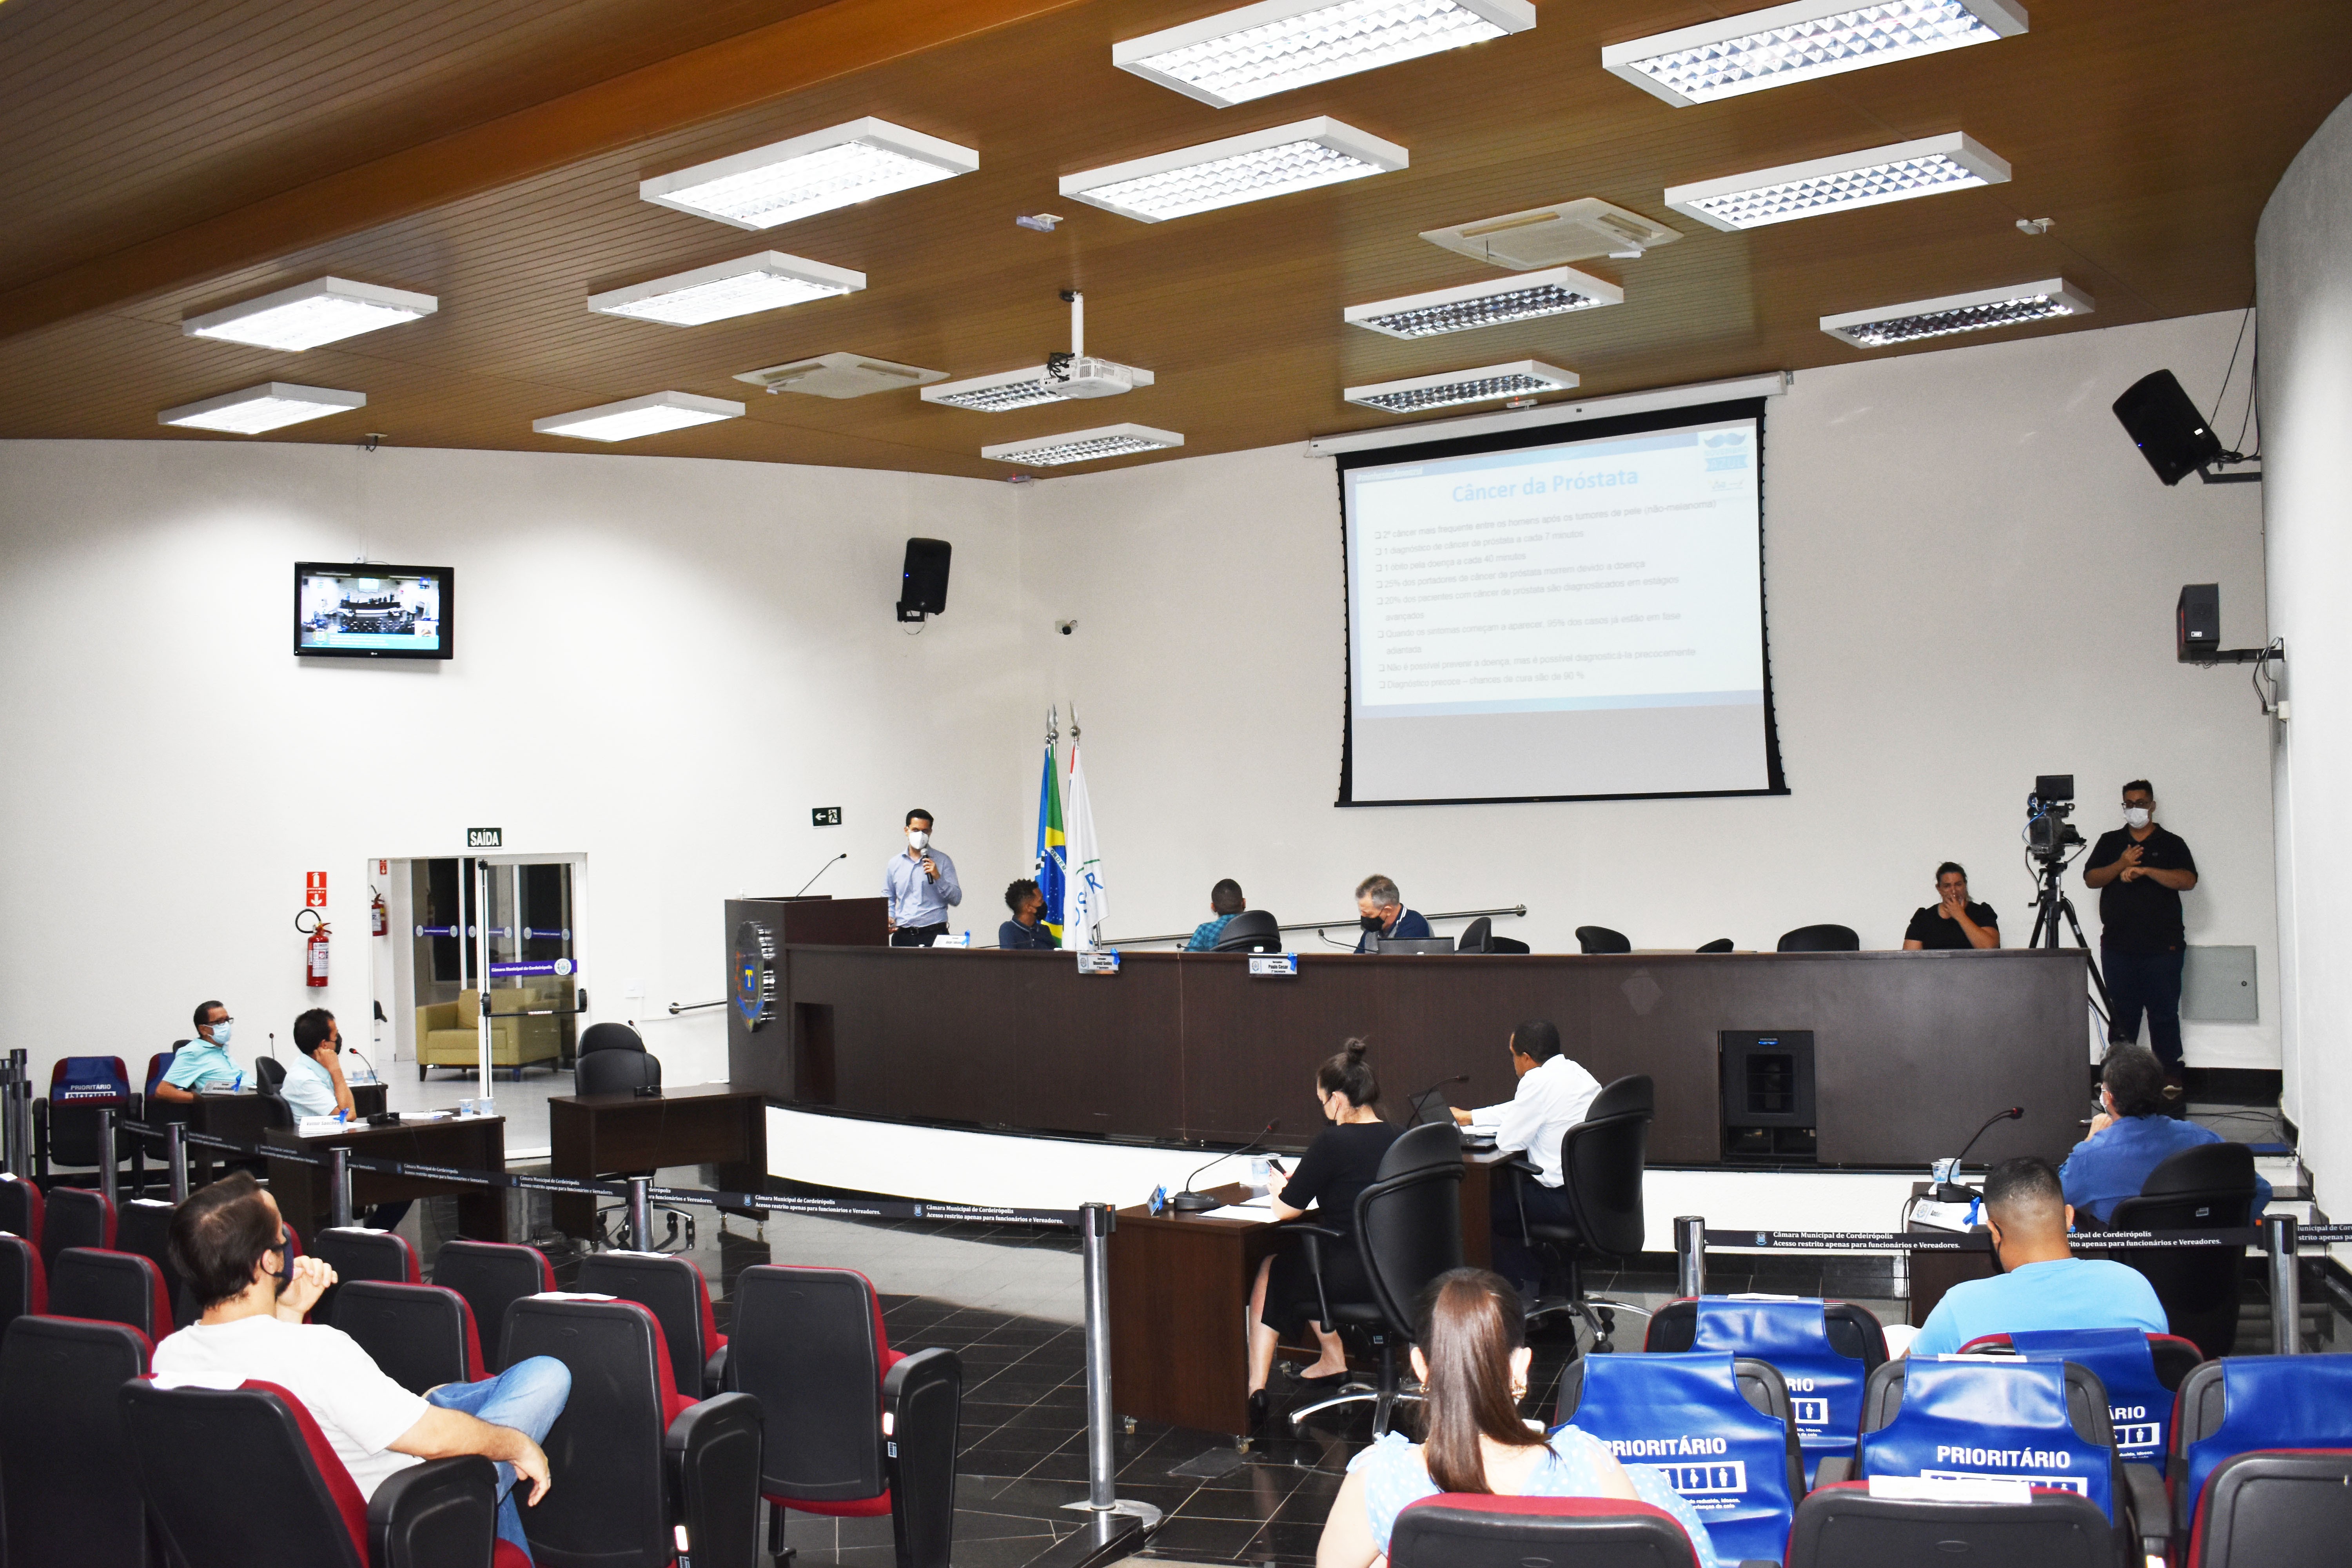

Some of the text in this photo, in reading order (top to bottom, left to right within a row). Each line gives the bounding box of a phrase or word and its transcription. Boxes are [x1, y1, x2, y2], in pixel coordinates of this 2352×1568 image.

[1711, 458, 1744, 469] AZUL
[1453, 470, 1638, 502] Câncer da Próstata
[470, 829, 499, 846] SAÍDA
[1050, 849, 1066, 870] ORDEM
[1846, 1232, 1893, 1241] Cordeirópolis
[1937, 1445, 2071, 1468] PRIORITÁRIO
